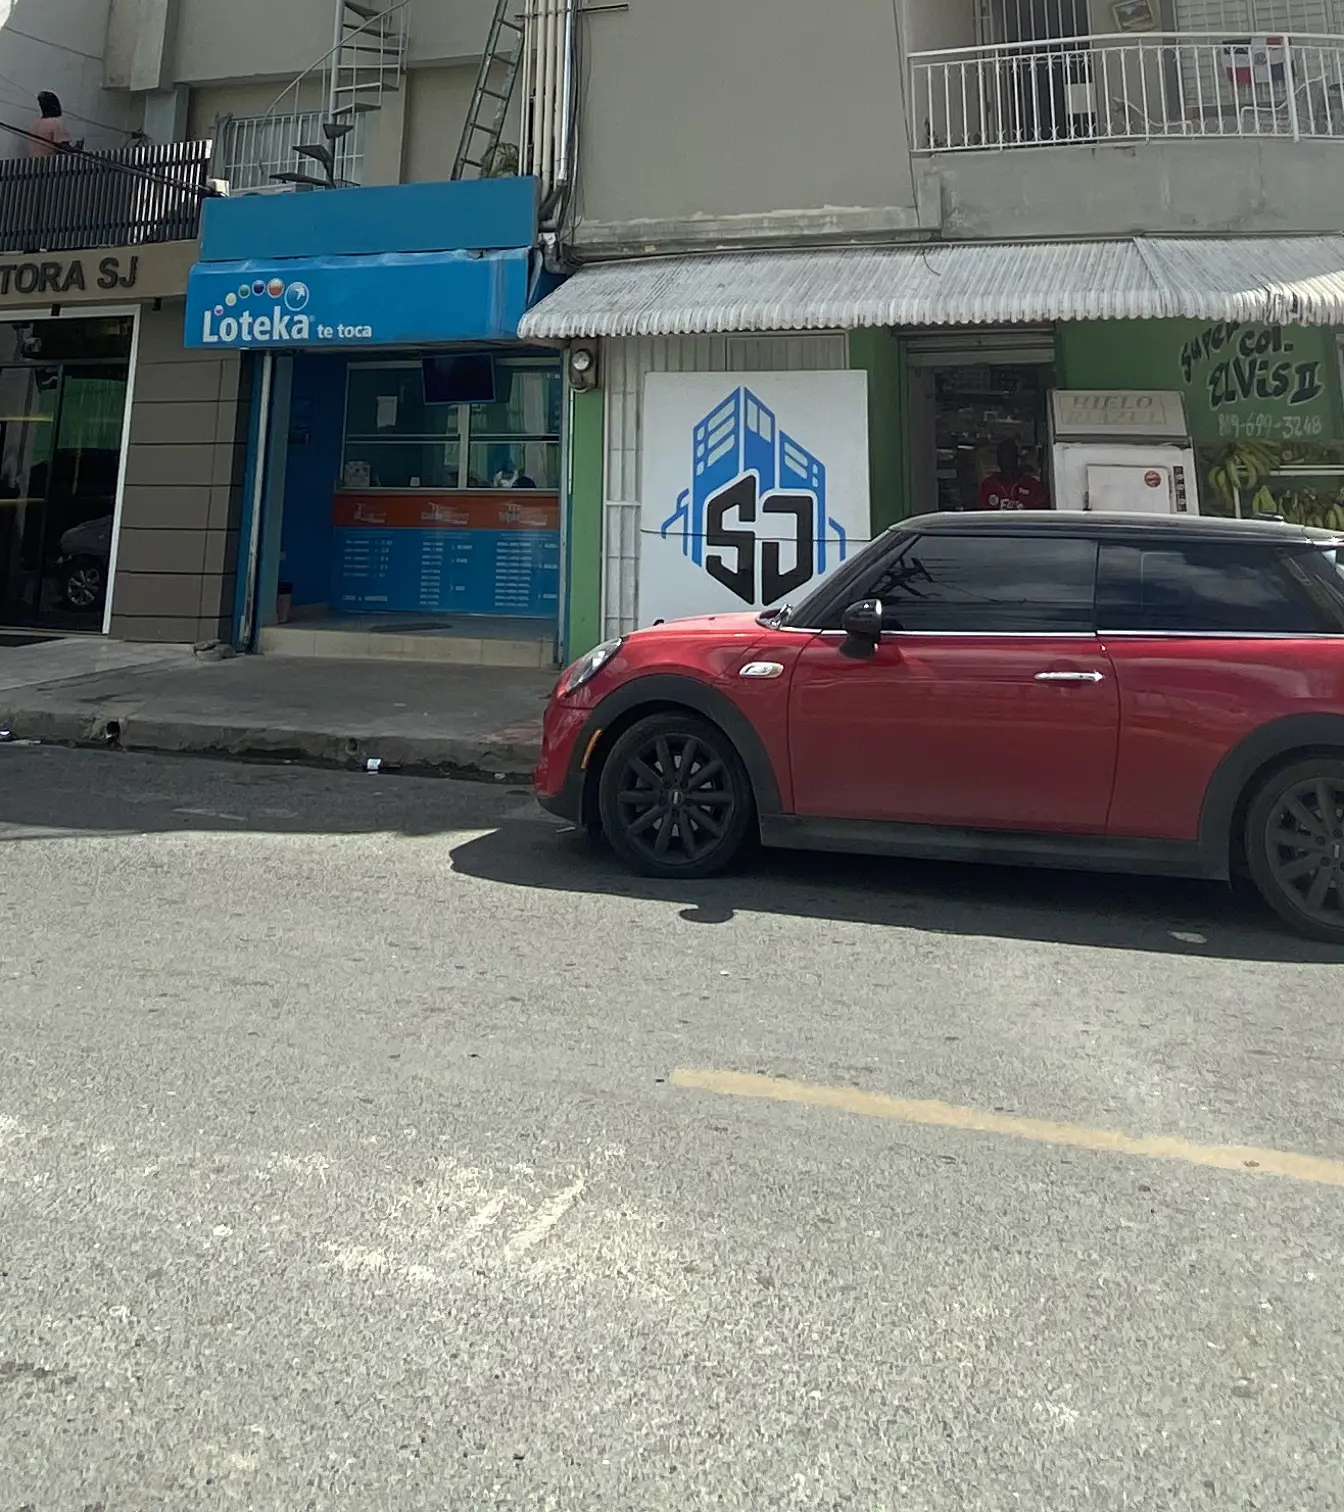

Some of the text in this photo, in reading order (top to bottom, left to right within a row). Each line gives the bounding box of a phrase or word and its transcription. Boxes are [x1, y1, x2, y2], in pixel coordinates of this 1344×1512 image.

[97, 256, 138, 289] SJ
[203, 305, 372, 343] Loteka te toca
[1073, 395, 1153, 410] HIELO
[705, 474, 814, 606] SJ
